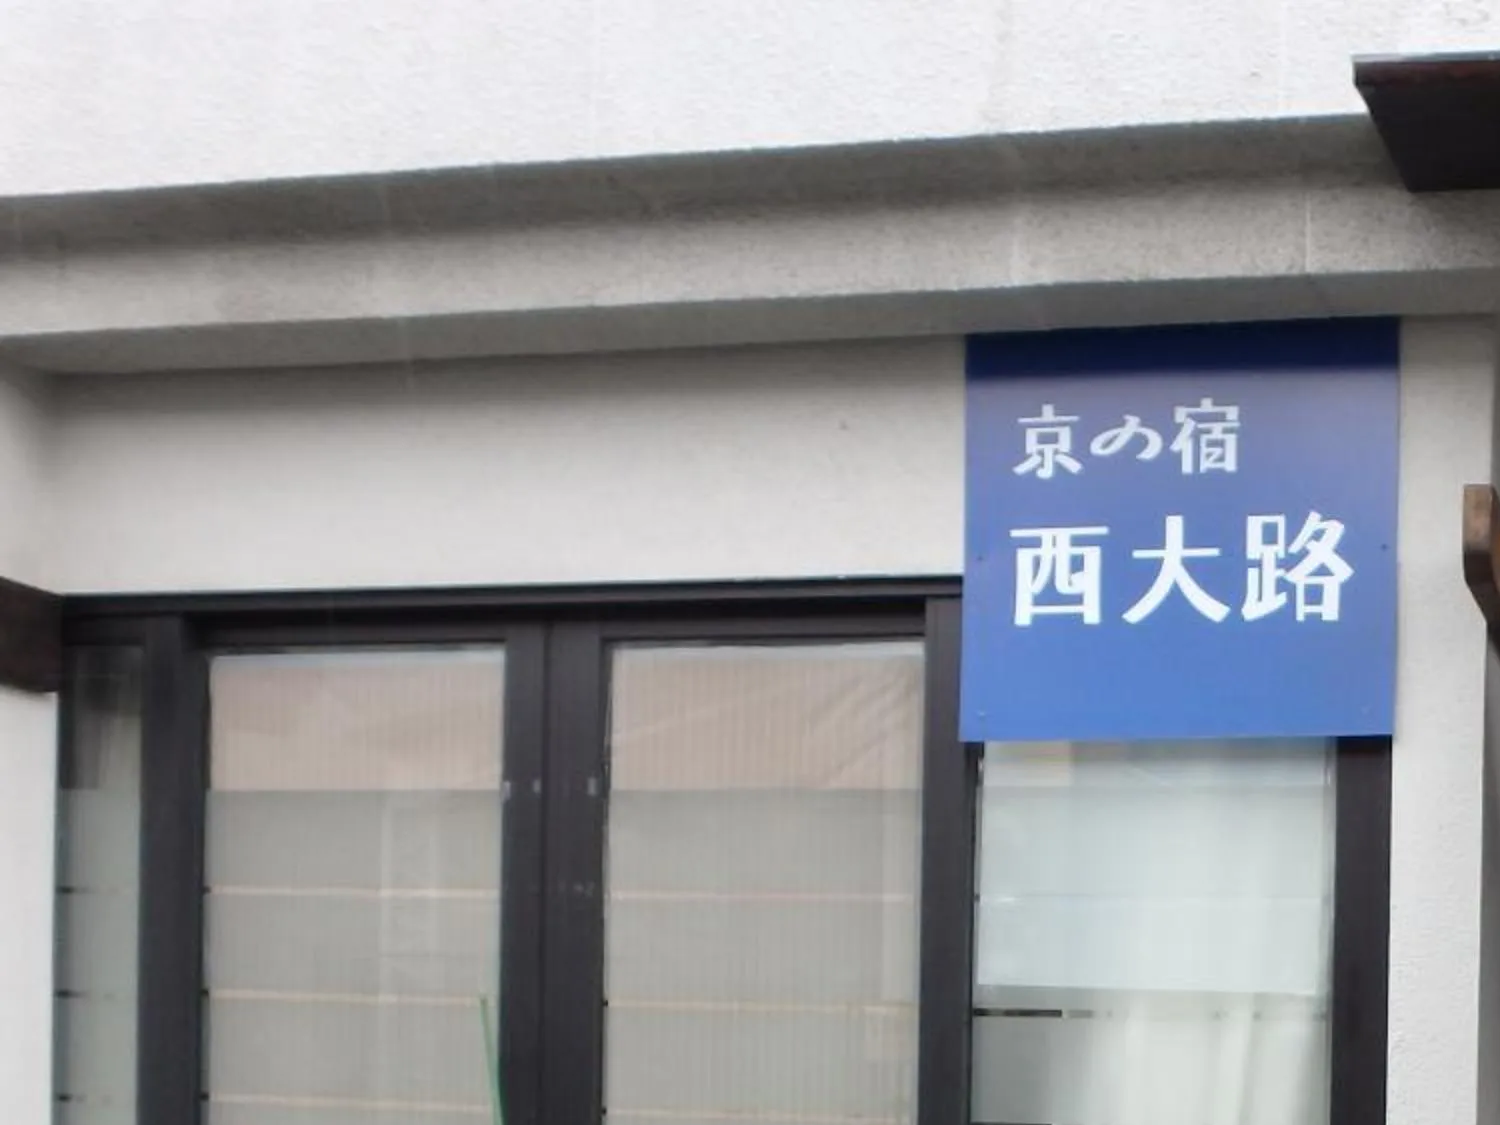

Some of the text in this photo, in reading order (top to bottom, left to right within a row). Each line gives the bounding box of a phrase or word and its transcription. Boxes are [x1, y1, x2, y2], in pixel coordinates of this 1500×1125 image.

[1013, 398, 1241, 479] 京の宿
[1010, 511, 1355, 626] 西大路
